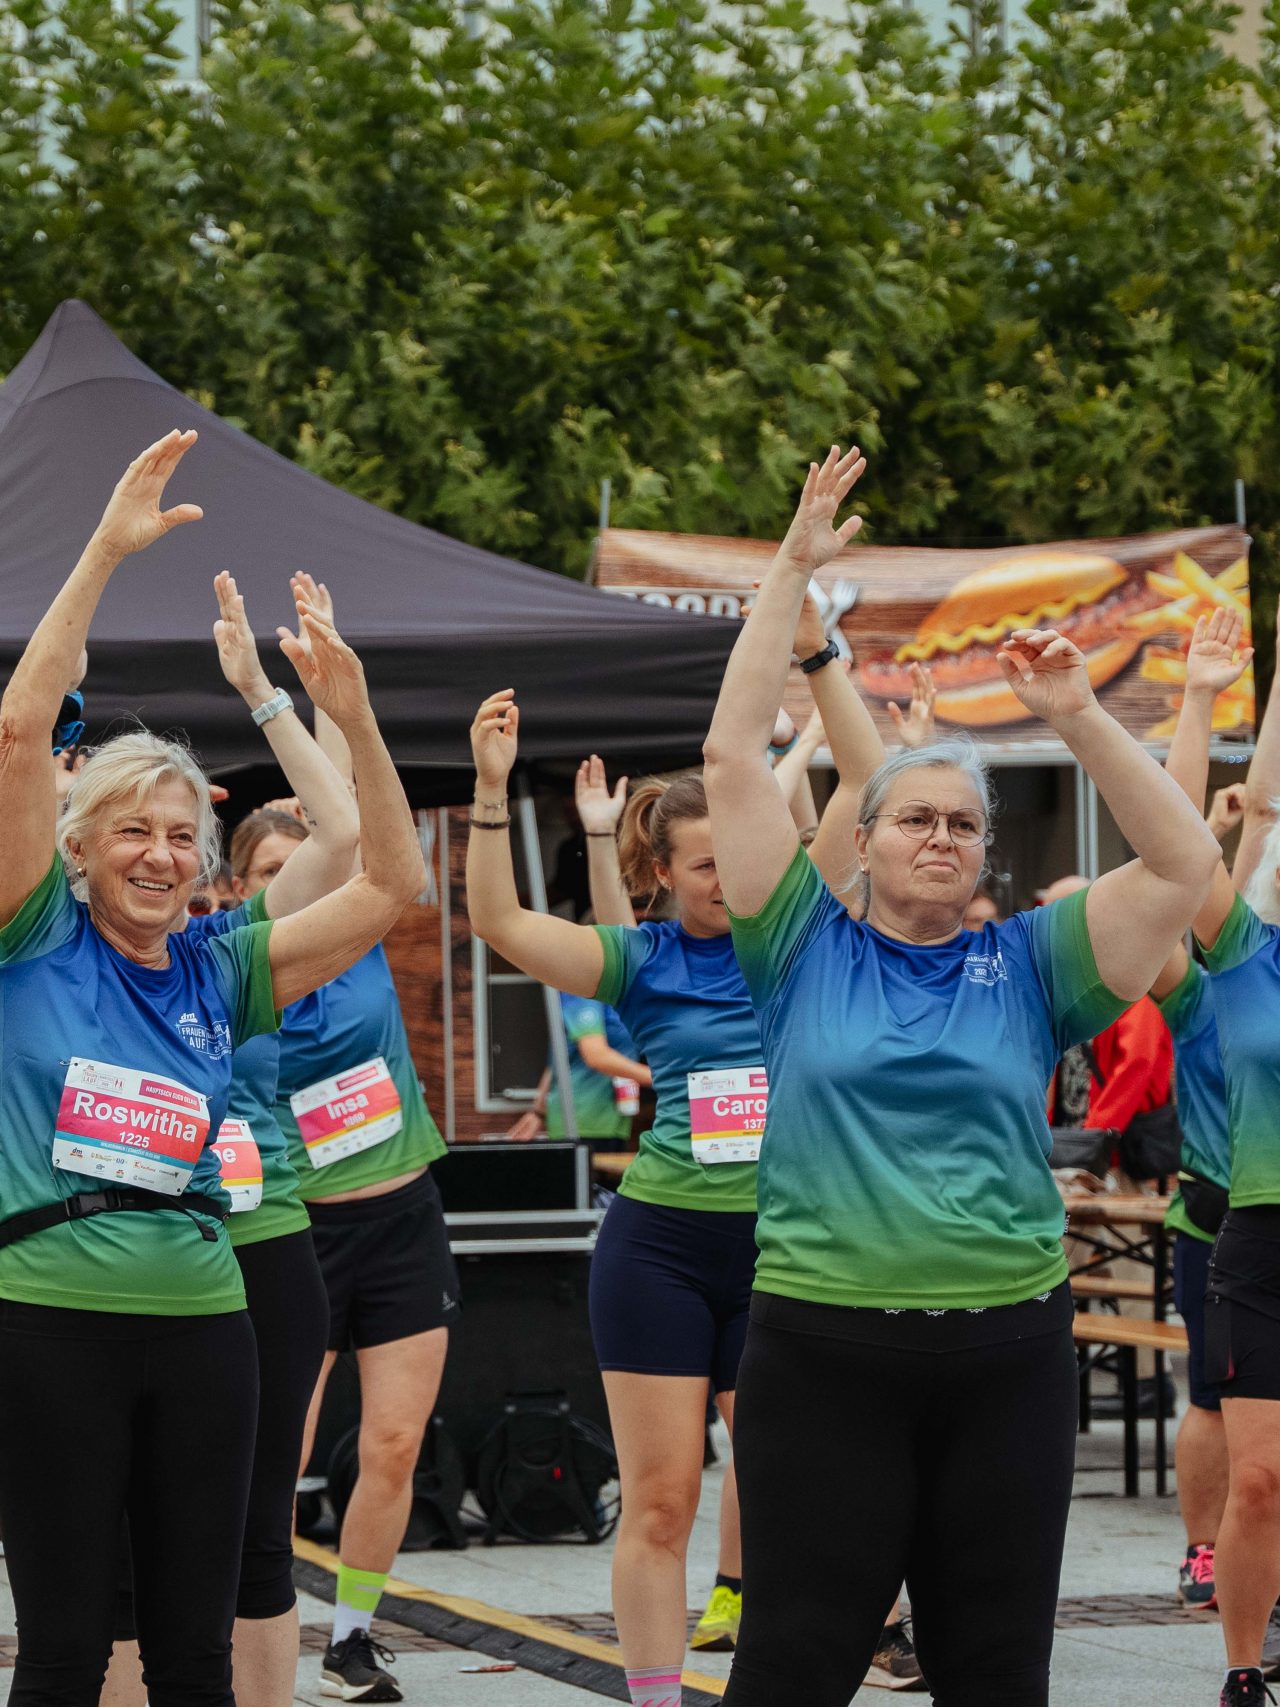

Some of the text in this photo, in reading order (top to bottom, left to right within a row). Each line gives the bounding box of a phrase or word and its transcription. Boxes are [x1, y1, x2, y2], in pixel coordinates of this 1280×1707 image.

[181, 1027, 206, 1038] FRAUEN
[183, 1037, 206, 1050] AUF
[325, 1093, 369, 1120] Insa
[712, 1096, 767, 1117] Caro
[72, 1091, 198, 1143] Roswitha
[119, 1131, 150, 1148] 1225
